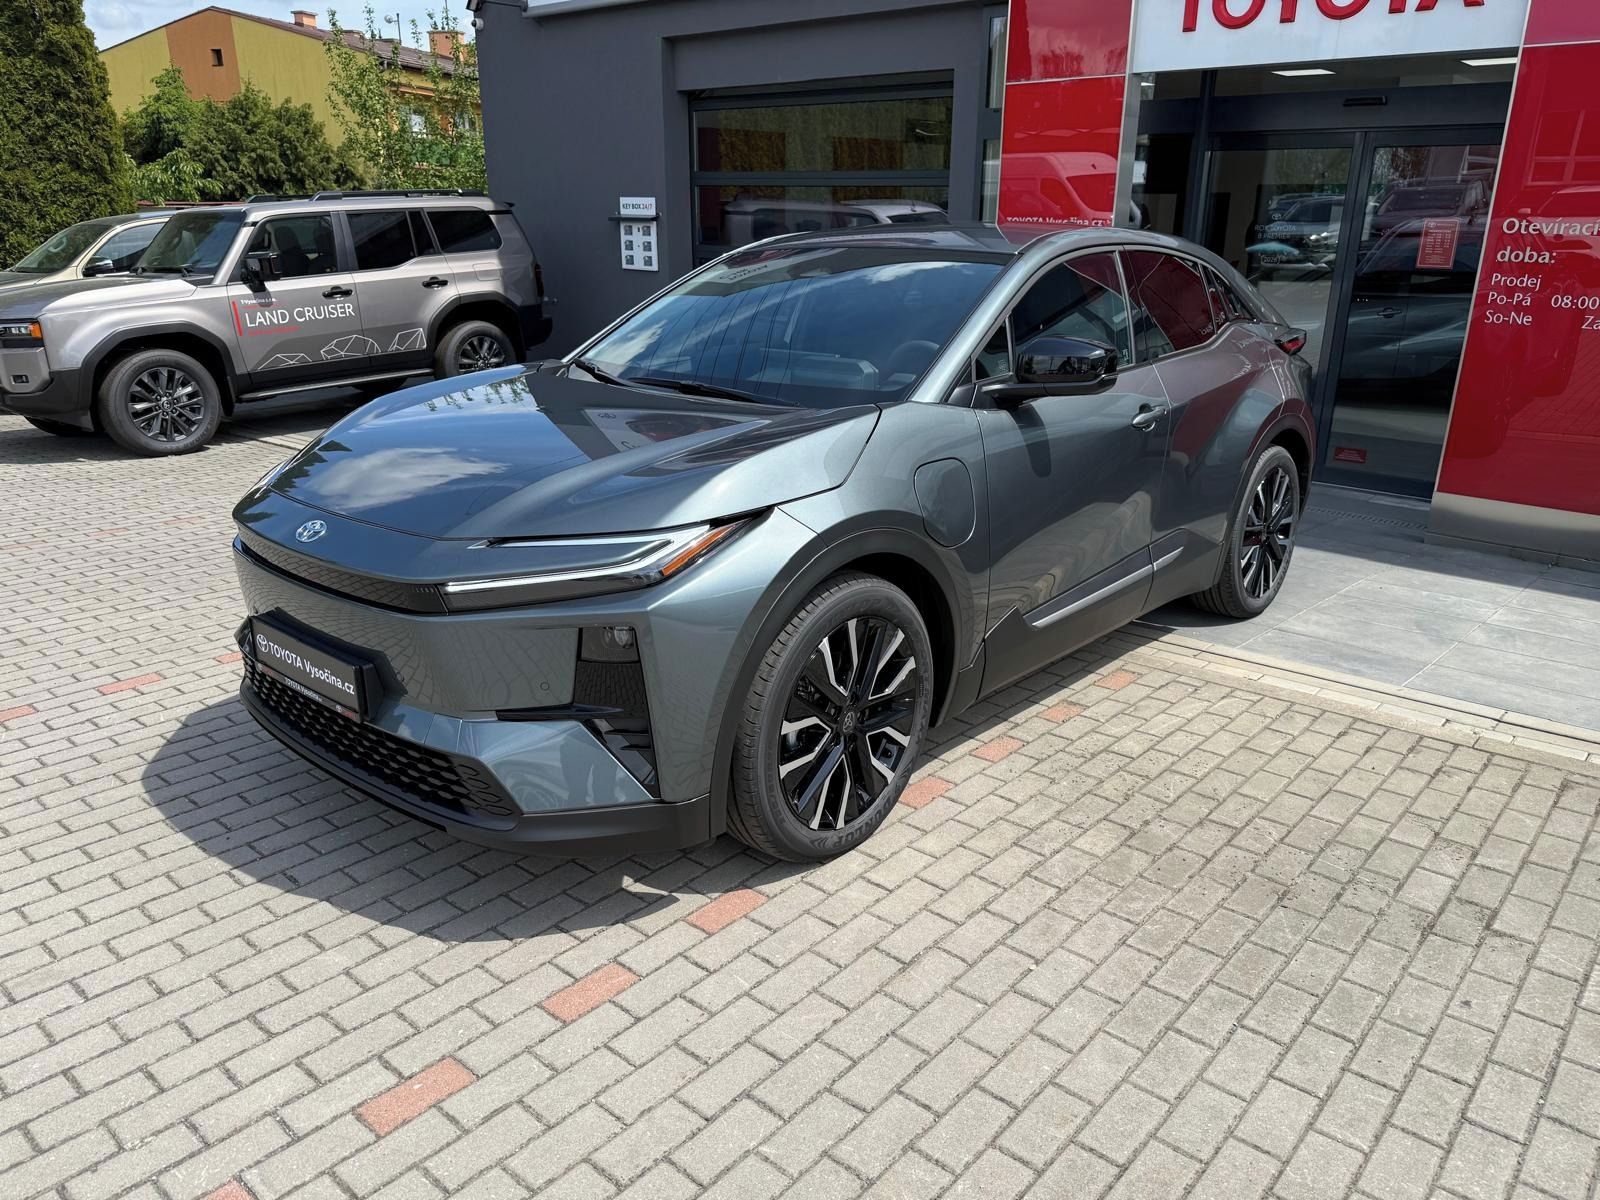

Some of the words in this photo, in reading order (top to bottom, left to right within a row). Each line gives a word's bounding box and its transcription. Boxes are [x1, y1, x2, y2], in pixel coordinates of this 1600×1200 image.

[1502, 217, 1600, 235] Otevírací
[1496, 246, 1557, 263] doba:
[1491, 273, 1542, 291] Prodej
[1487, 291, 1532, 306] Po-Pá
[1551, 294, 1600, 310] 08:00
[245, 309, 289, 327] LAND
[293, 303, 355, 321] CRUISER
[1484, 309, 1533, 326] So-Ne
[268, 642, 303, 670] TOYOTA
[304, 659, 355, 694] Vysočina.cz
